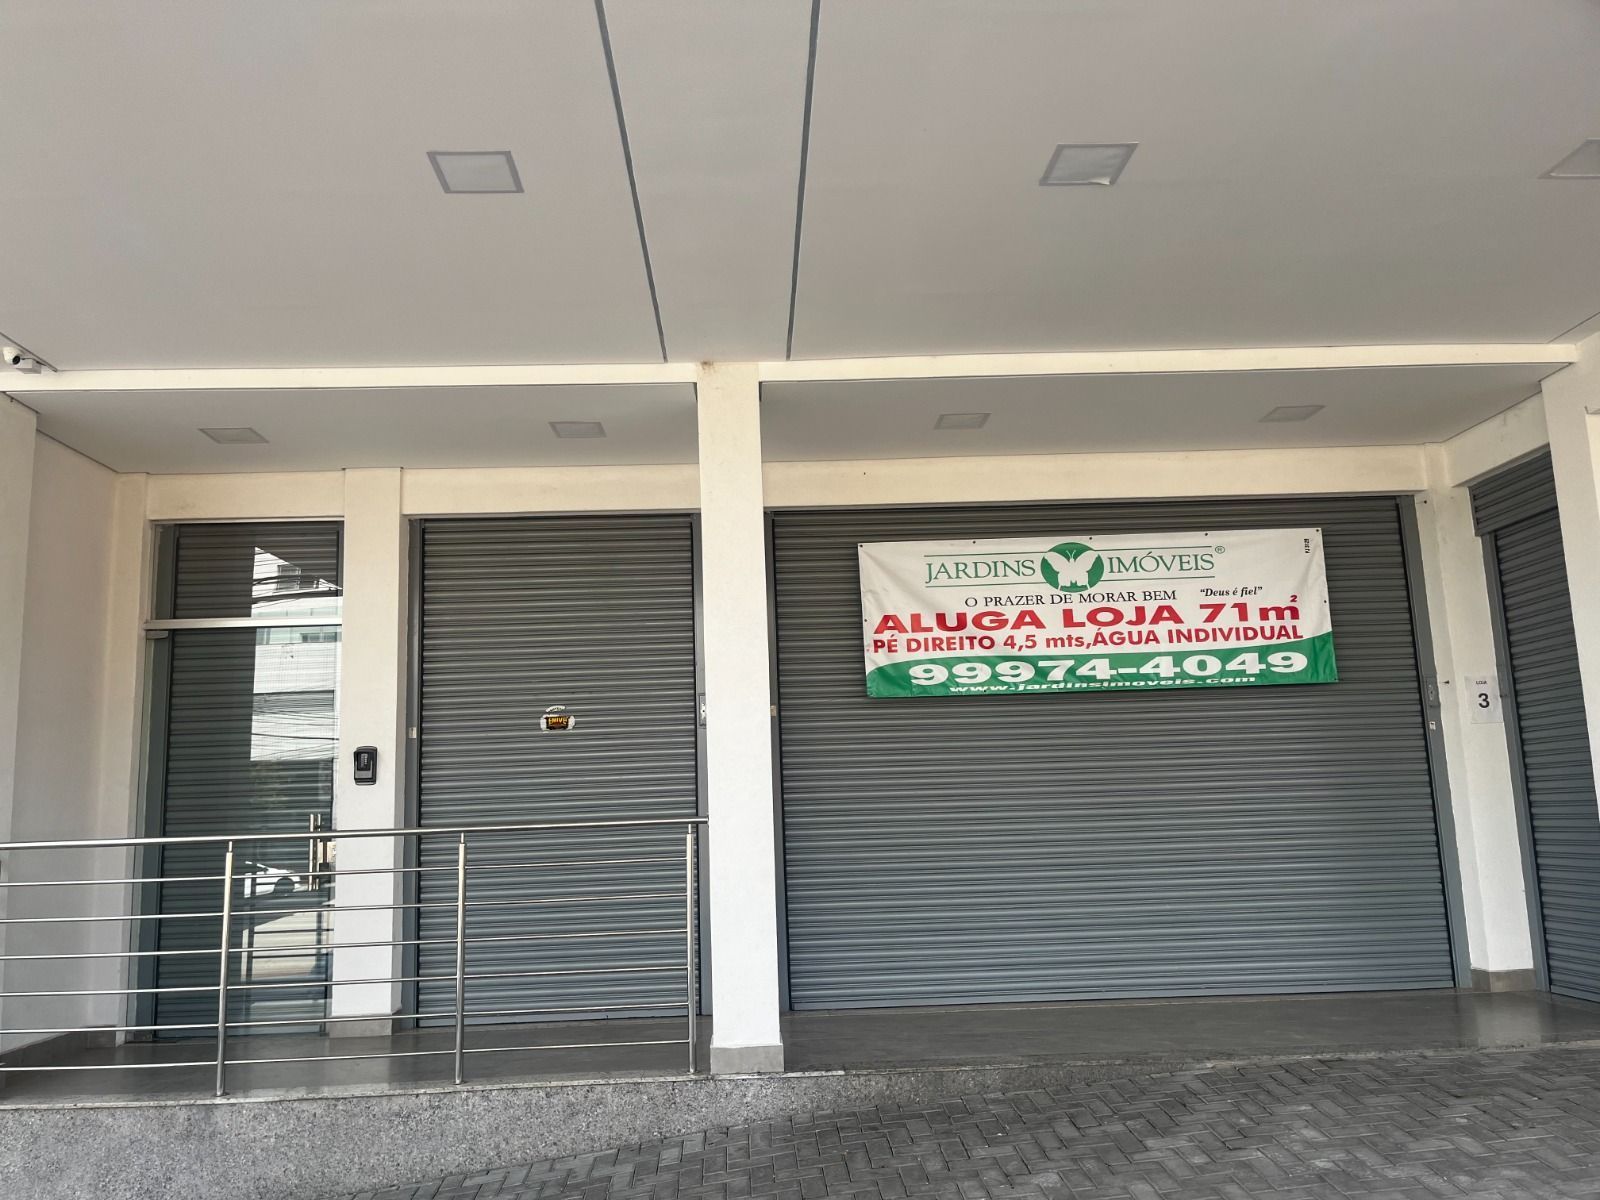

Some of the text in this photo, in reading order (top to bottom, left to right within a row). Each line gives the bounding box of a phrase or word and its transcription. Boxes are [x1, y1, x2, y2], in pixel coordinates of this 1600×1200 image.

[925, 551, 1215, 584] JARDINS IMÓVEIS
[965, 590, 1177, 608] O PRAZER DE MORAR BEM
[1232, 587, 1238, 596] é
[873, 609, 1046, 635] ALUGA
[1062, 604, 1185, 629] LOJA
[873, 634, 898, 654] PÉ
[906, 635, 996, 652] DIREITO
[1003, 634, 1037, 652] 4,5
[1167, 625, 1304, 644] INDIVIDUAL
[908, 652, 1308, 686] 99974-4049
[1478, 693, 1490, 709] 3
